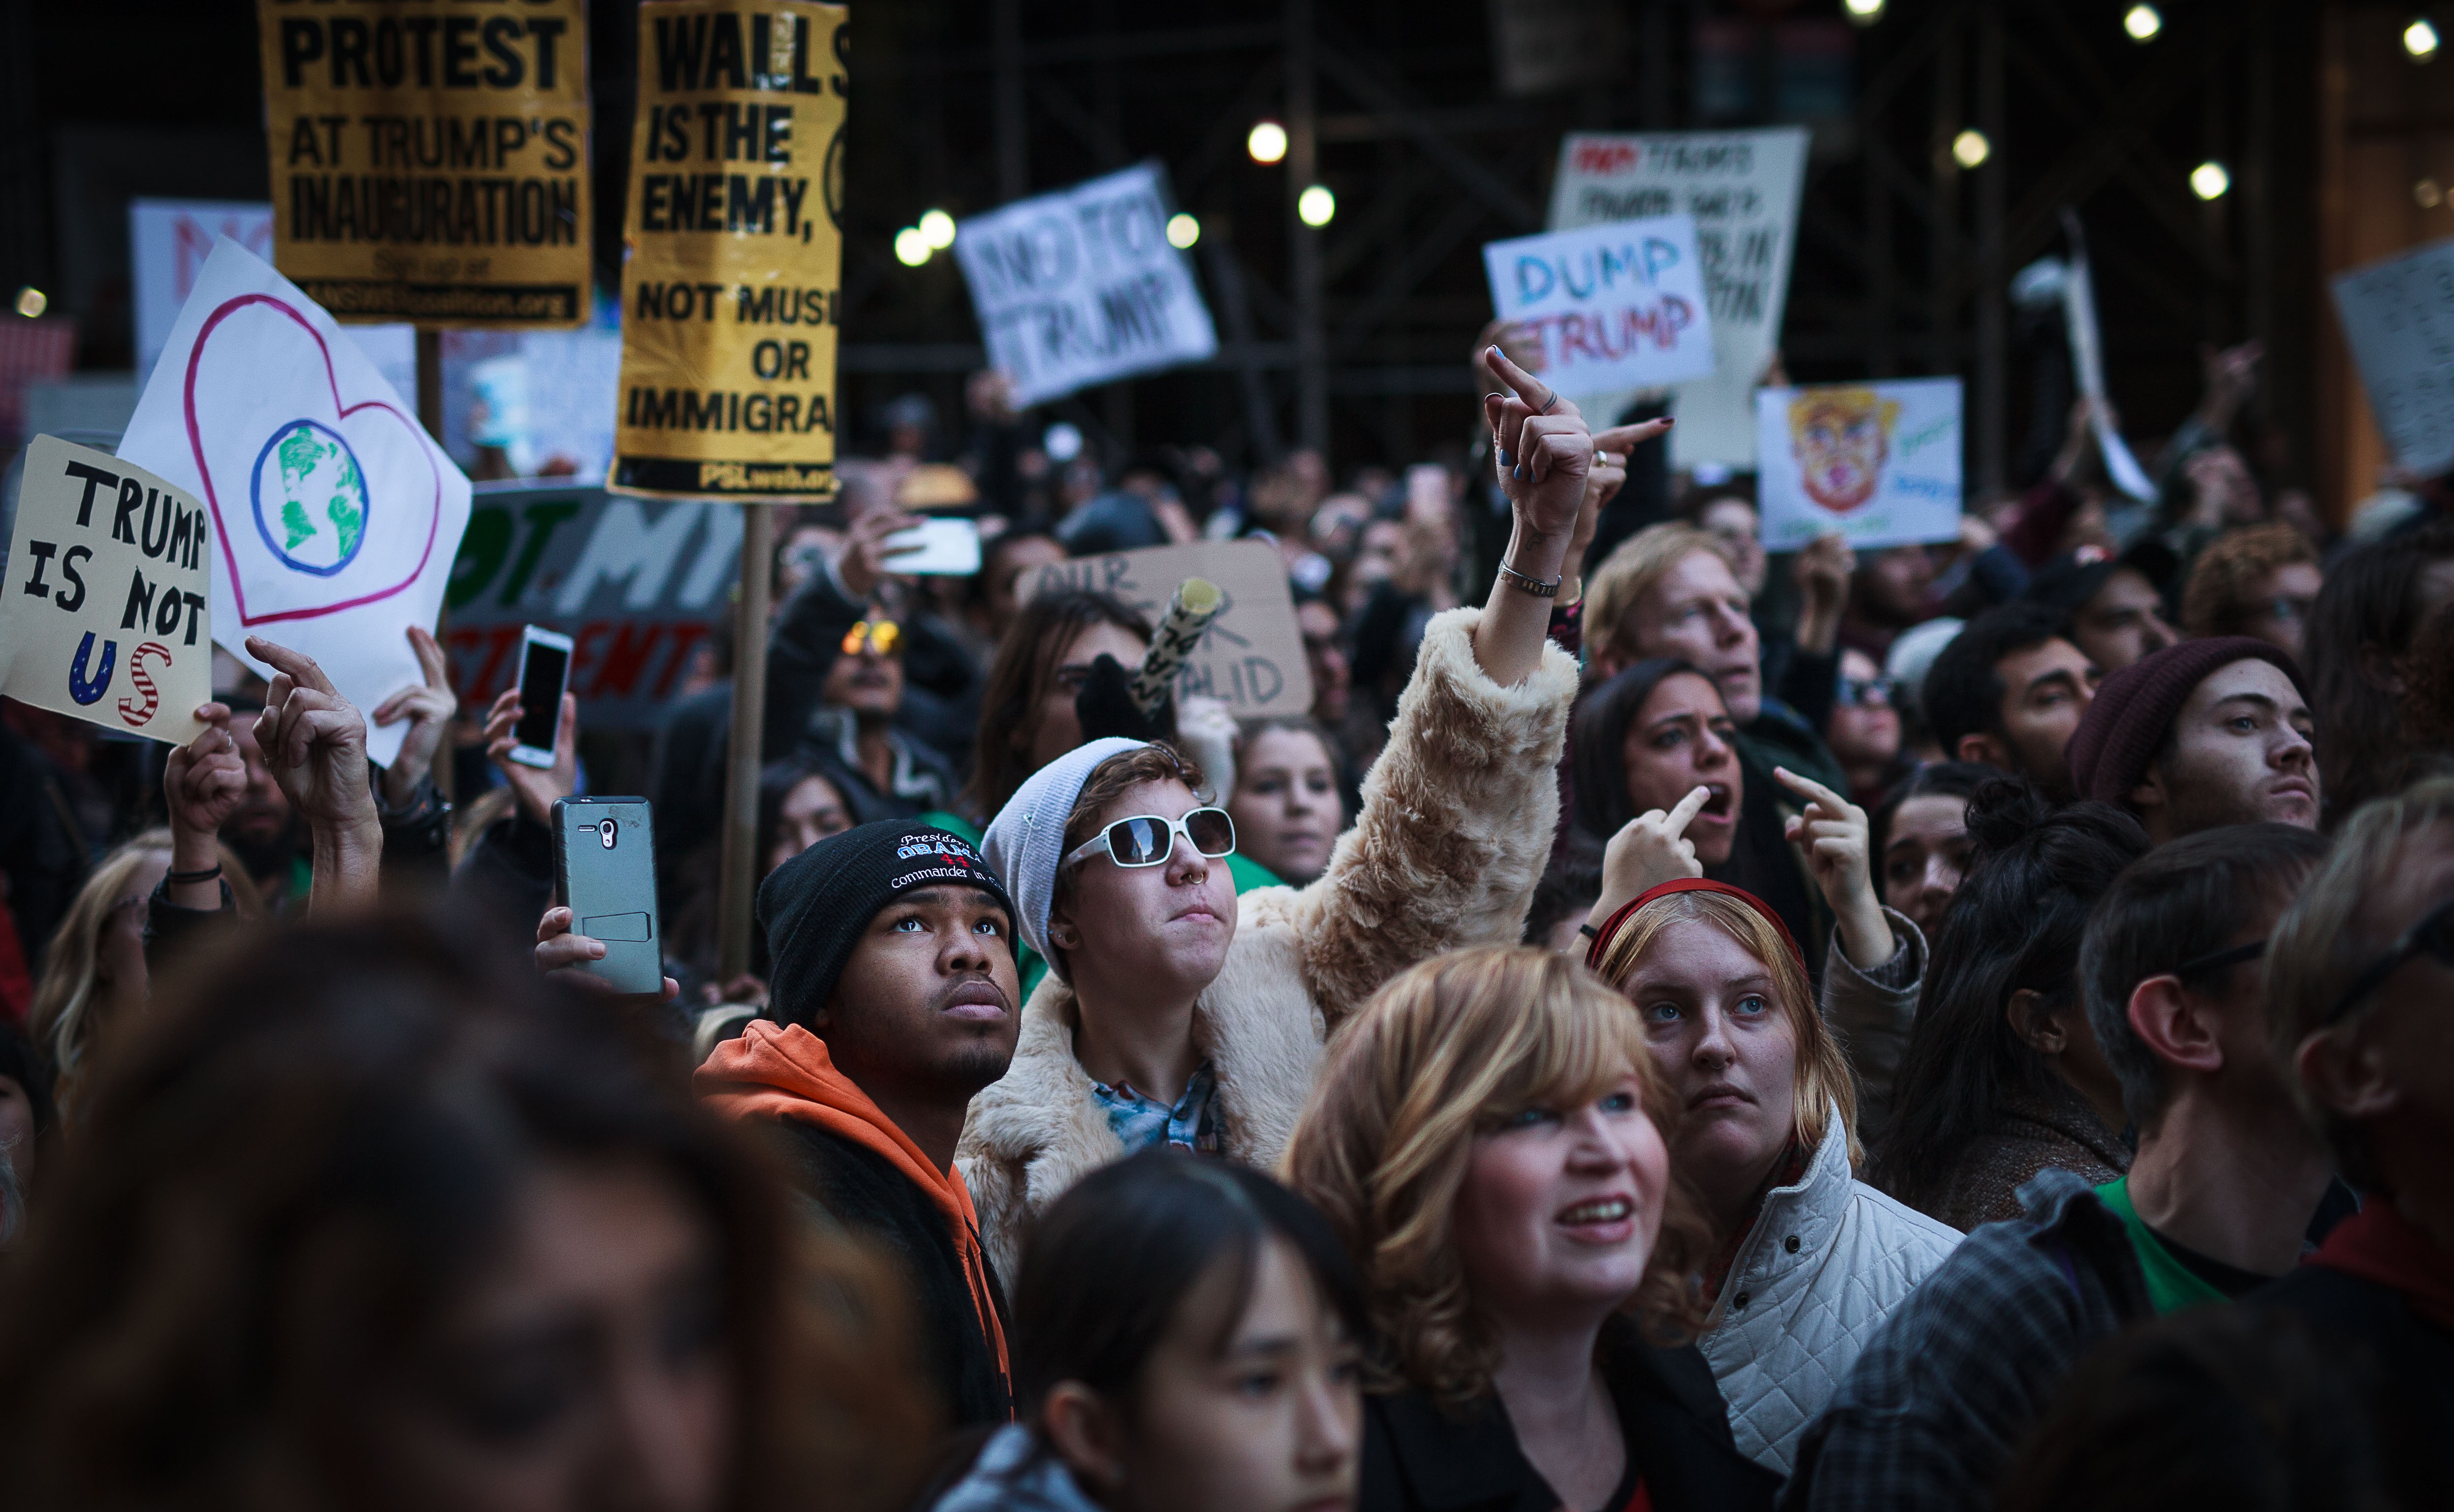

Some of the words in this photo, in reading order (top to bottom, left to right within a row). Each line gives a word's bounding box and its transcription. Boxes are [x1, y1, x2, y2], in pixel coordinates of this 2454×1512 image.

[281, 17, 567, 91] PROTEST
[287, 117, 348, 168] AT
[362, 117, 576, 170] TRUMP'S
[647, 103, 689, 162] IS
[699, 102, 794, 163] THE
[642, 173, 813, 244] ENEMY,
[638, 282, 724, 321] NOT
[1515, 235, 1681, 307] DUMP
[753, 339, 810, 380] OR
[988, 269, 1174, 379] TRUMP
[1523, 294, 1696, 372] TRUMP
[627, 387, 833, 433] IMMIGRA
[65, 460, 206, 570] TRUMP
[24, 539, 93, 613] IS
[120, 565, 205, 646] NOT
[68, 630, 172, 727] US
[897, 841, 983, 864] OBAMA
[940, 854, 970, 867] 44
